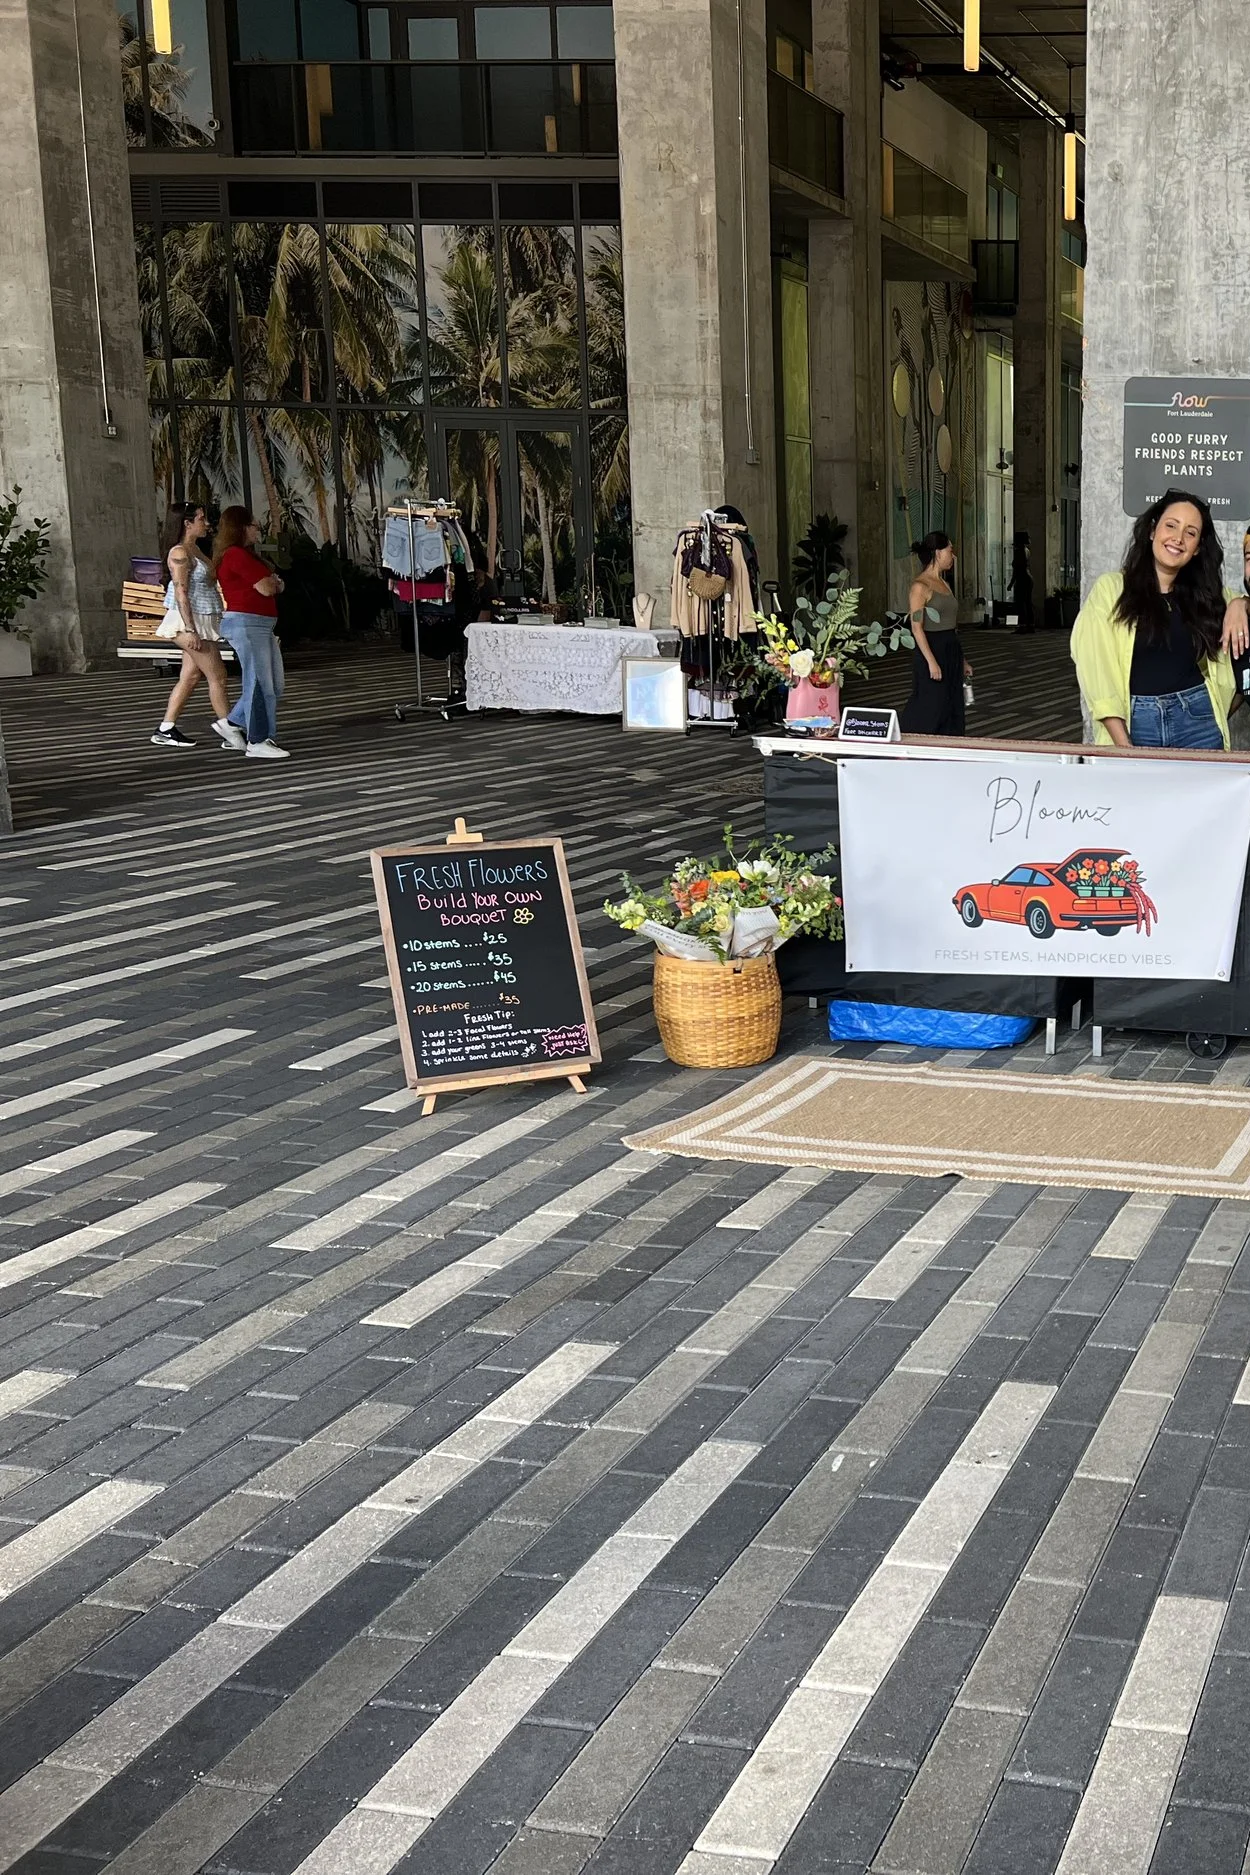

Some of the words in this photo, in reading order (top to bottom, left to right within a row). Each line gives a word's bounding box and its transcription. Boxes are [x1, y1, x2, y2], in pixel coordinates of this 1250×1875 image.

[1180, 410, 1213, 418] Lauderdale
[1151, 433, 1182, 444] GOOD
[1188, 434, 1228, 445] FURRY
[1135, 448, 1185, 460] FRIENDS
[1190, 450, 1243, 462] RESPECT
[1164, 464, 1213, 476] PLANTS
[986, 776, 1112, 843] Bloomz
[396, 861, 463, 892] FRESH
[417, 892, 468, 911] Build
[483, 931, 508, 945] $25
[412, 960, 427, 973] 15
[487, 951, 513, 966] $35
[934, 949, 979, 961] FRESH
[1037, 951, 1128, 965] HANDPICKED
[416, 981, 431, 993] 20
[493, 970, 517, 983] $45
[417, 1001, 471, 1016] PRE-MADE
[499, 992, 520, 1005] $35
[429, 1029, 445, 1038] add
[431, 1039, 446, 1047] add
[431, 1047, 446, 1056] add
